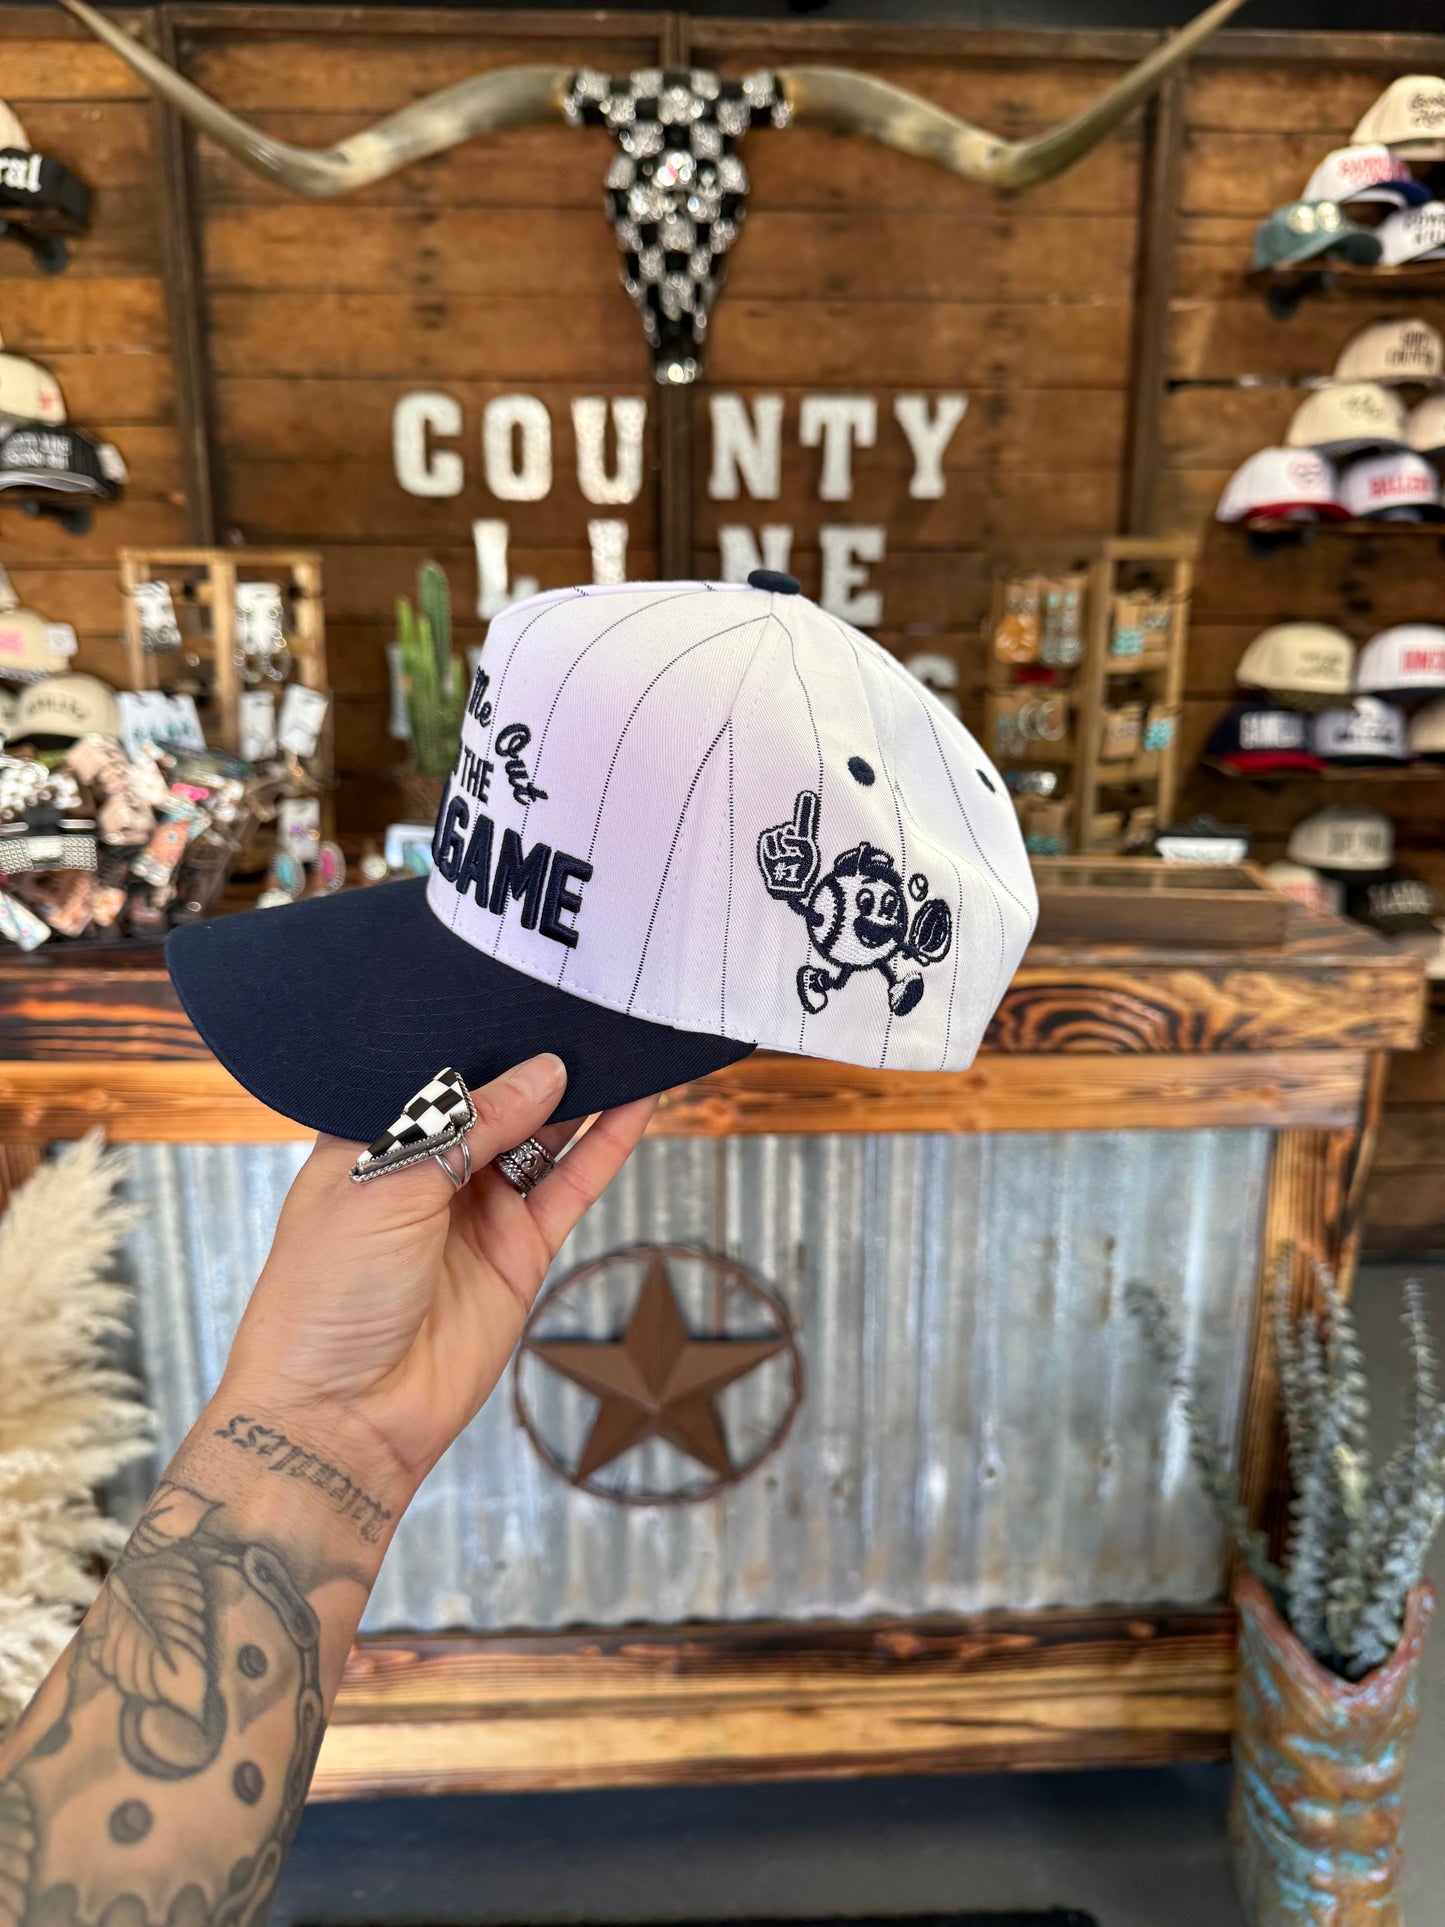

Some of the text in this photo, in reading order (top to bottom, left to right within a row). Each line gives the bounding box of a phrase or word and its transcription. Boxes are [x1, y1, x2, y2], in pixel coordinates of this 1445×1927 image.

[393, 393, 970, 505] COUNTY
[461, 745, 494, 804] THE
[495, 723, 549, 806] Out
[213, 1414, 391, 1545] Relentless
